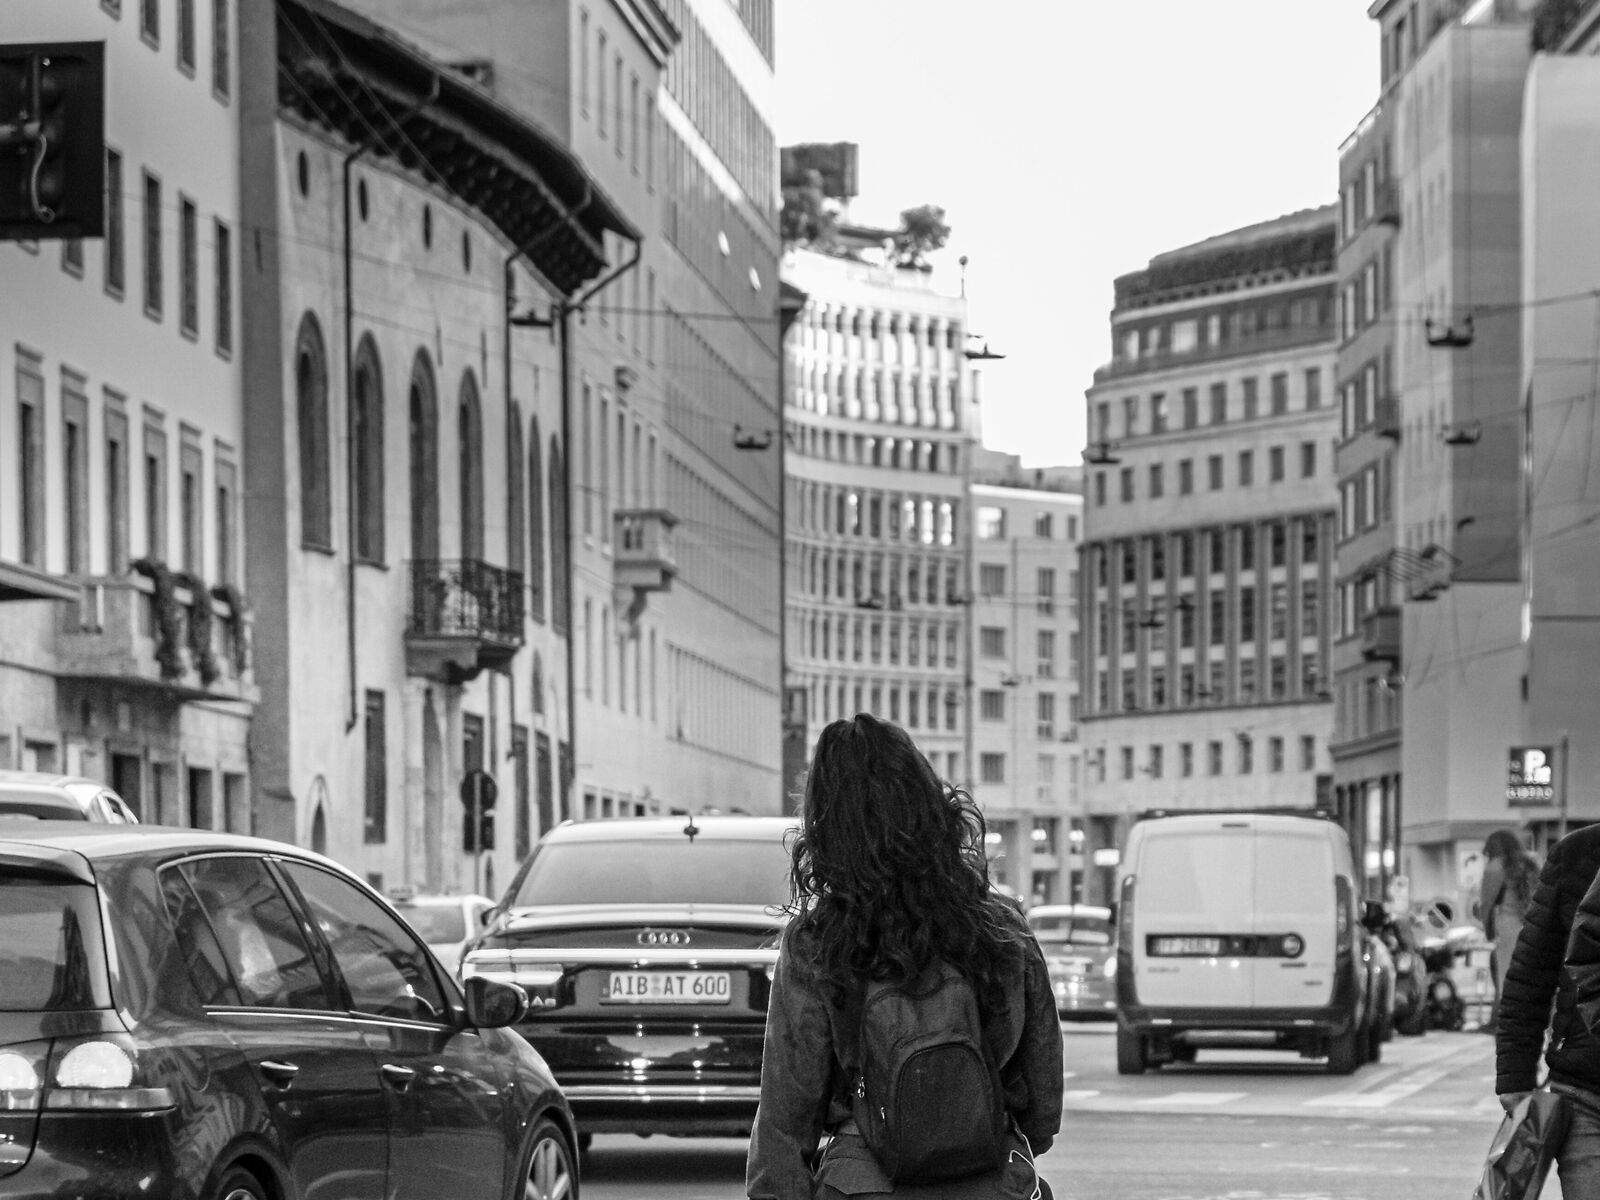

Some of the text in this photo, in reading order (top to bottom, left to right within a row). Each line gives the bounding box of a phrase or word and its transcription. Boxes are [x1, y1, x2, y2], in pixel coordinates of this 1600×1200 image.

[612, 976, 648, 996] AIB
[664, 976, 686, 996] AT
[693, 976, 727, 996] 600
